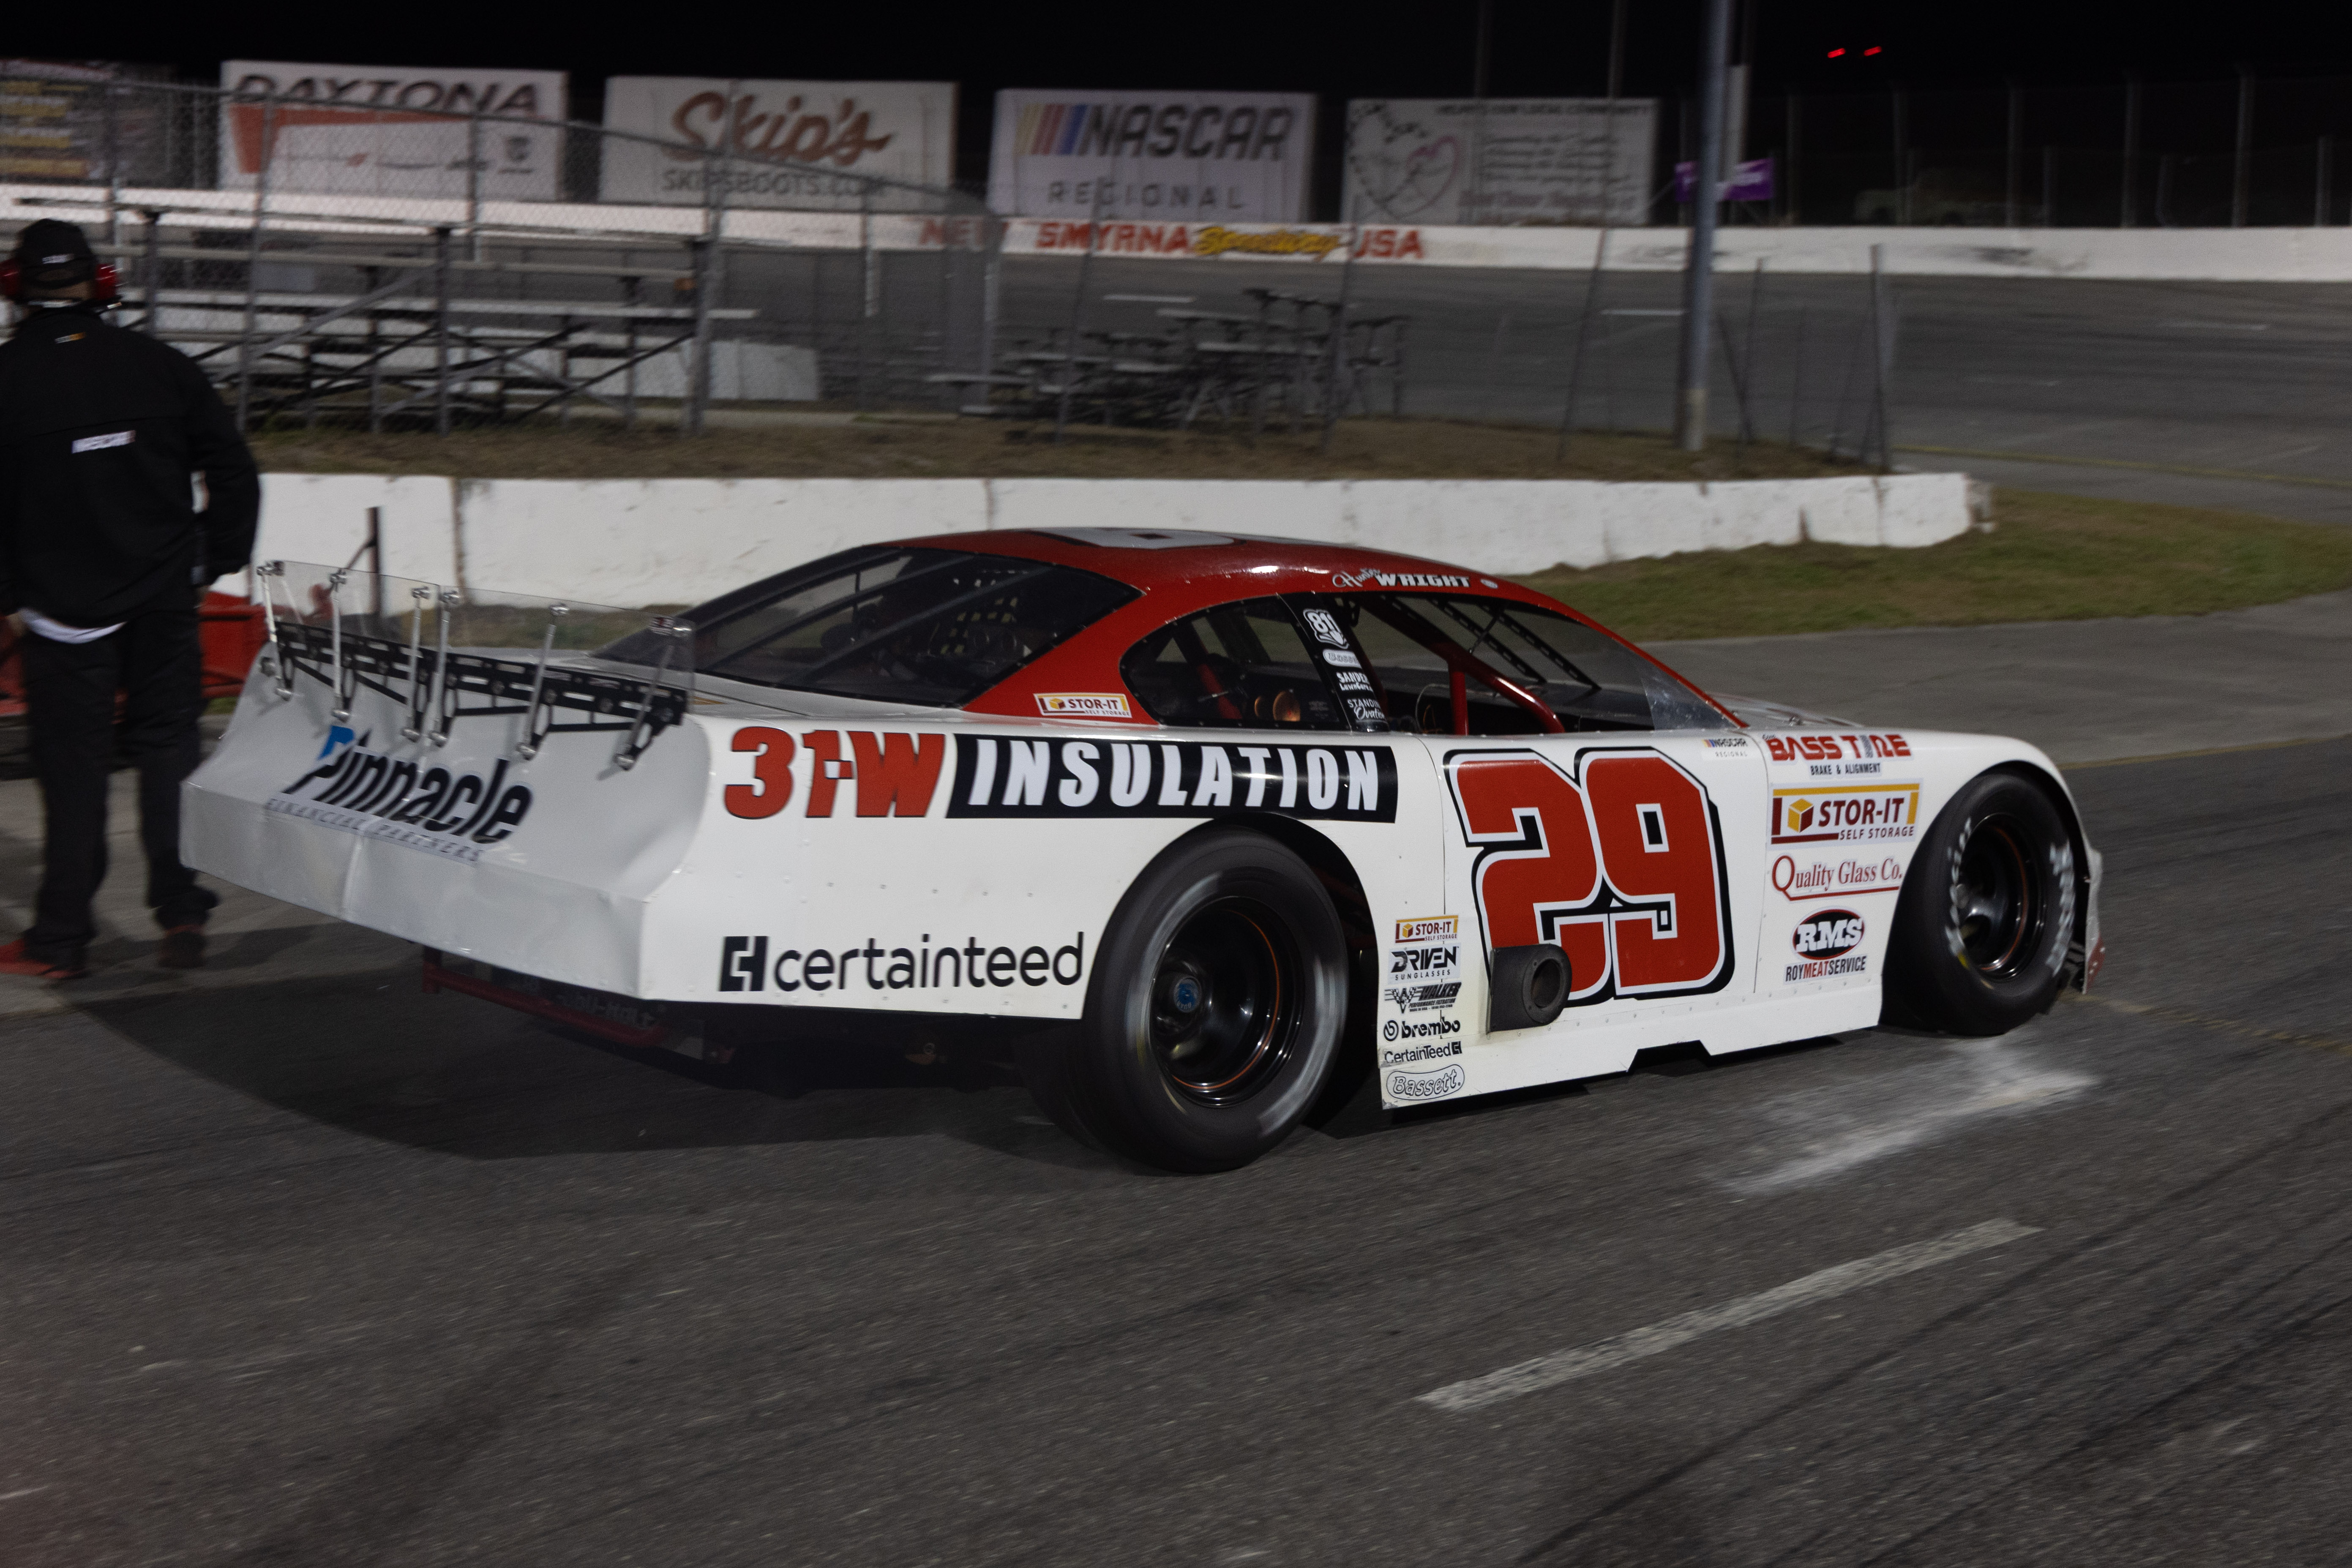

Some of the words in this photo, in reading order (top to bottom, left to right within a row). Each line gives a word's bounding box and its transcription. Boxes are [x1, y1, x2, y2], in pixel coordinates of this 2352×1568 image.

[235, 74, 538, 115] DAYTONA
[1078, 104, 1294, 161] NASCAR
[1048, 180, 1247, 210] REGIONAL
[1035, 221, 1191, 253] SMYRNA
[1374, 573, 1470, 587] WRIGHT
[1068, 699, 1118, 710] STOR-IT
[1714, 738, 1748, 747] NASCAR
[1765, 736, 1842, 761] BASS
[967, 739, 1380, 812] INSULATION
[1810, 765, 1832, 776] BRAKE
[1836, 765, 1841, 774] &
[1845, 763, 1881, 774] ALIGNMENT
[1818, 797, 1905, 827] STOR-IT
[1839, 829, 1864, 840] SELF
[1868, 826, 1914, 838] STORAGE
[1443, 746, 1735, 1008] 29
[1772, 855, 1834, 892] Quality
[1839, 861, 1876, 885] Glass
[1881, 858, 1902, 881] Co.
[1415, 921, 1452, 935] STOR-IT
[1796, 919, 1864, 953] RMS
[773, 931, 1084, 991] certainteed
[1391, 946, 1457, 973] DRIVEN
[1395, 969, 1450, 980] SUNGLASSES
[1402, 1017, 1460, 1039] brembo
[1384, 1042, 1452, 1064] CertainTeed
[1393, 1069, 1457, 1096] Bassett
